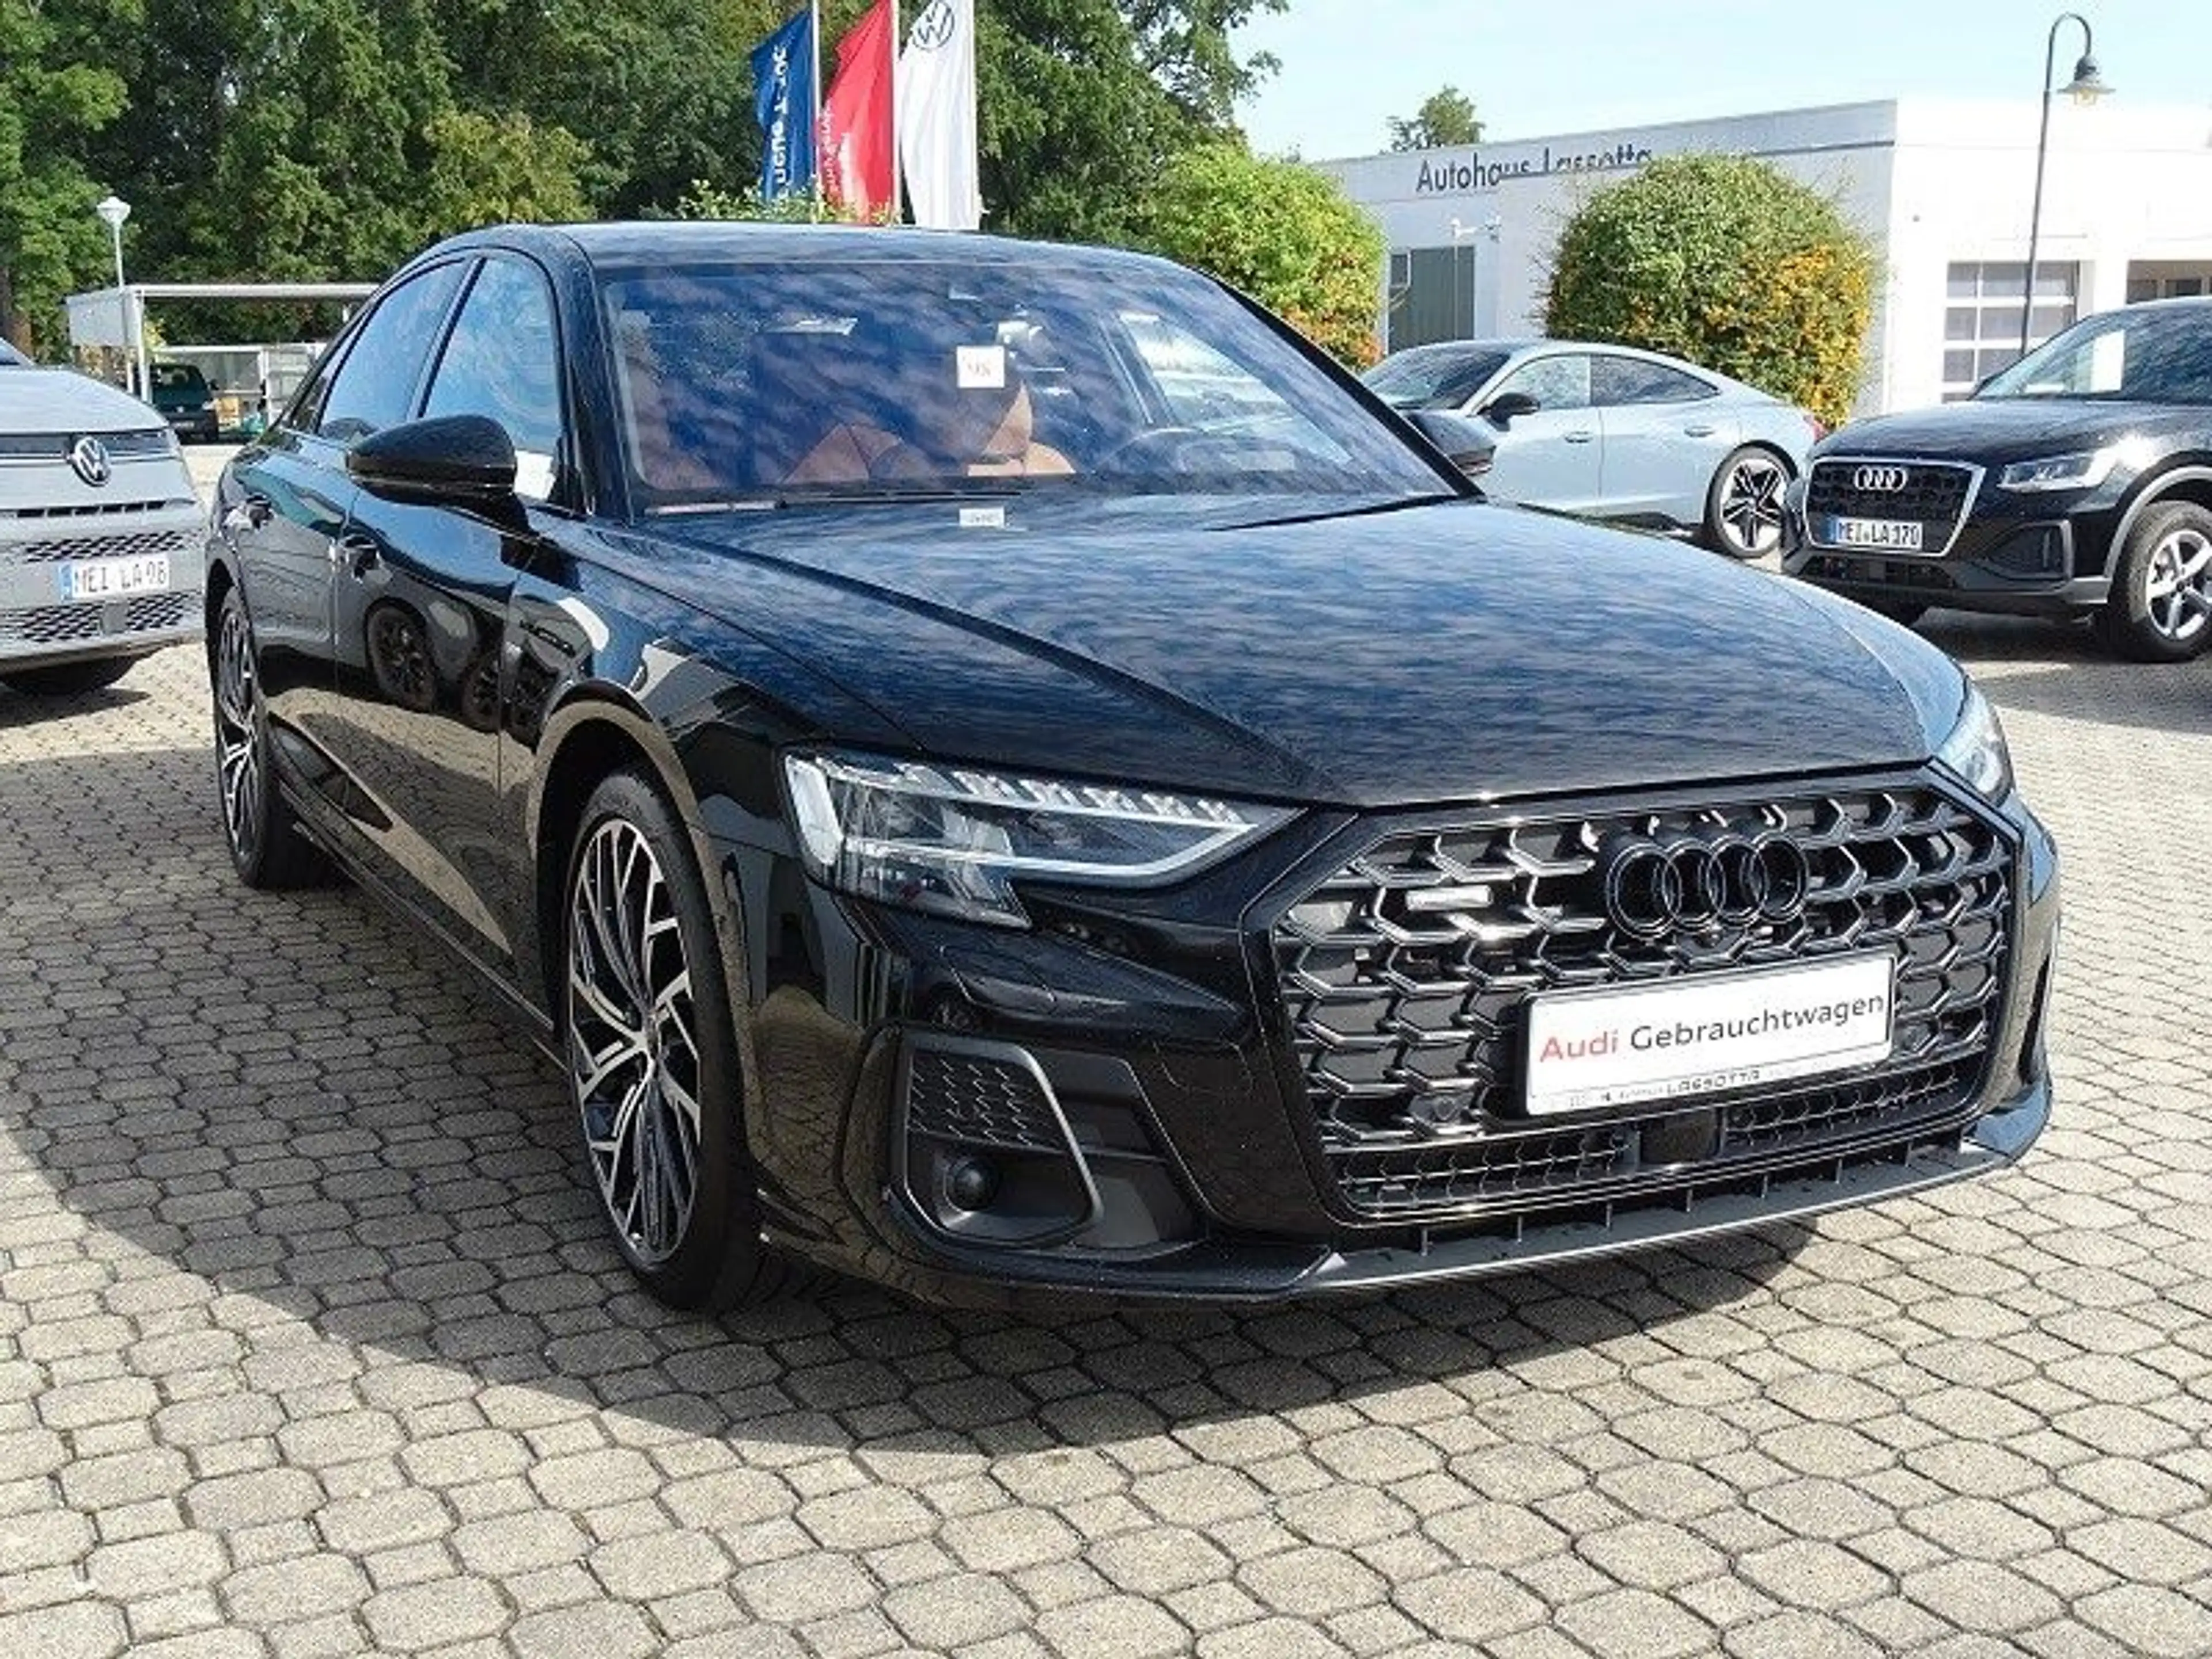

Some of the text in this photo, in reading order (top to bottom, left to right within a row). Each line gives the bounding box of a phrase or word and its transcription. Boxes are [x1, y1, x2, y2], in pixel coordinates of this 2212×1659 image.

[1416, 152, 1530, 192] Autohaus
[1539, 994, 1885, 1062] Audi Gebrauchtwagen
